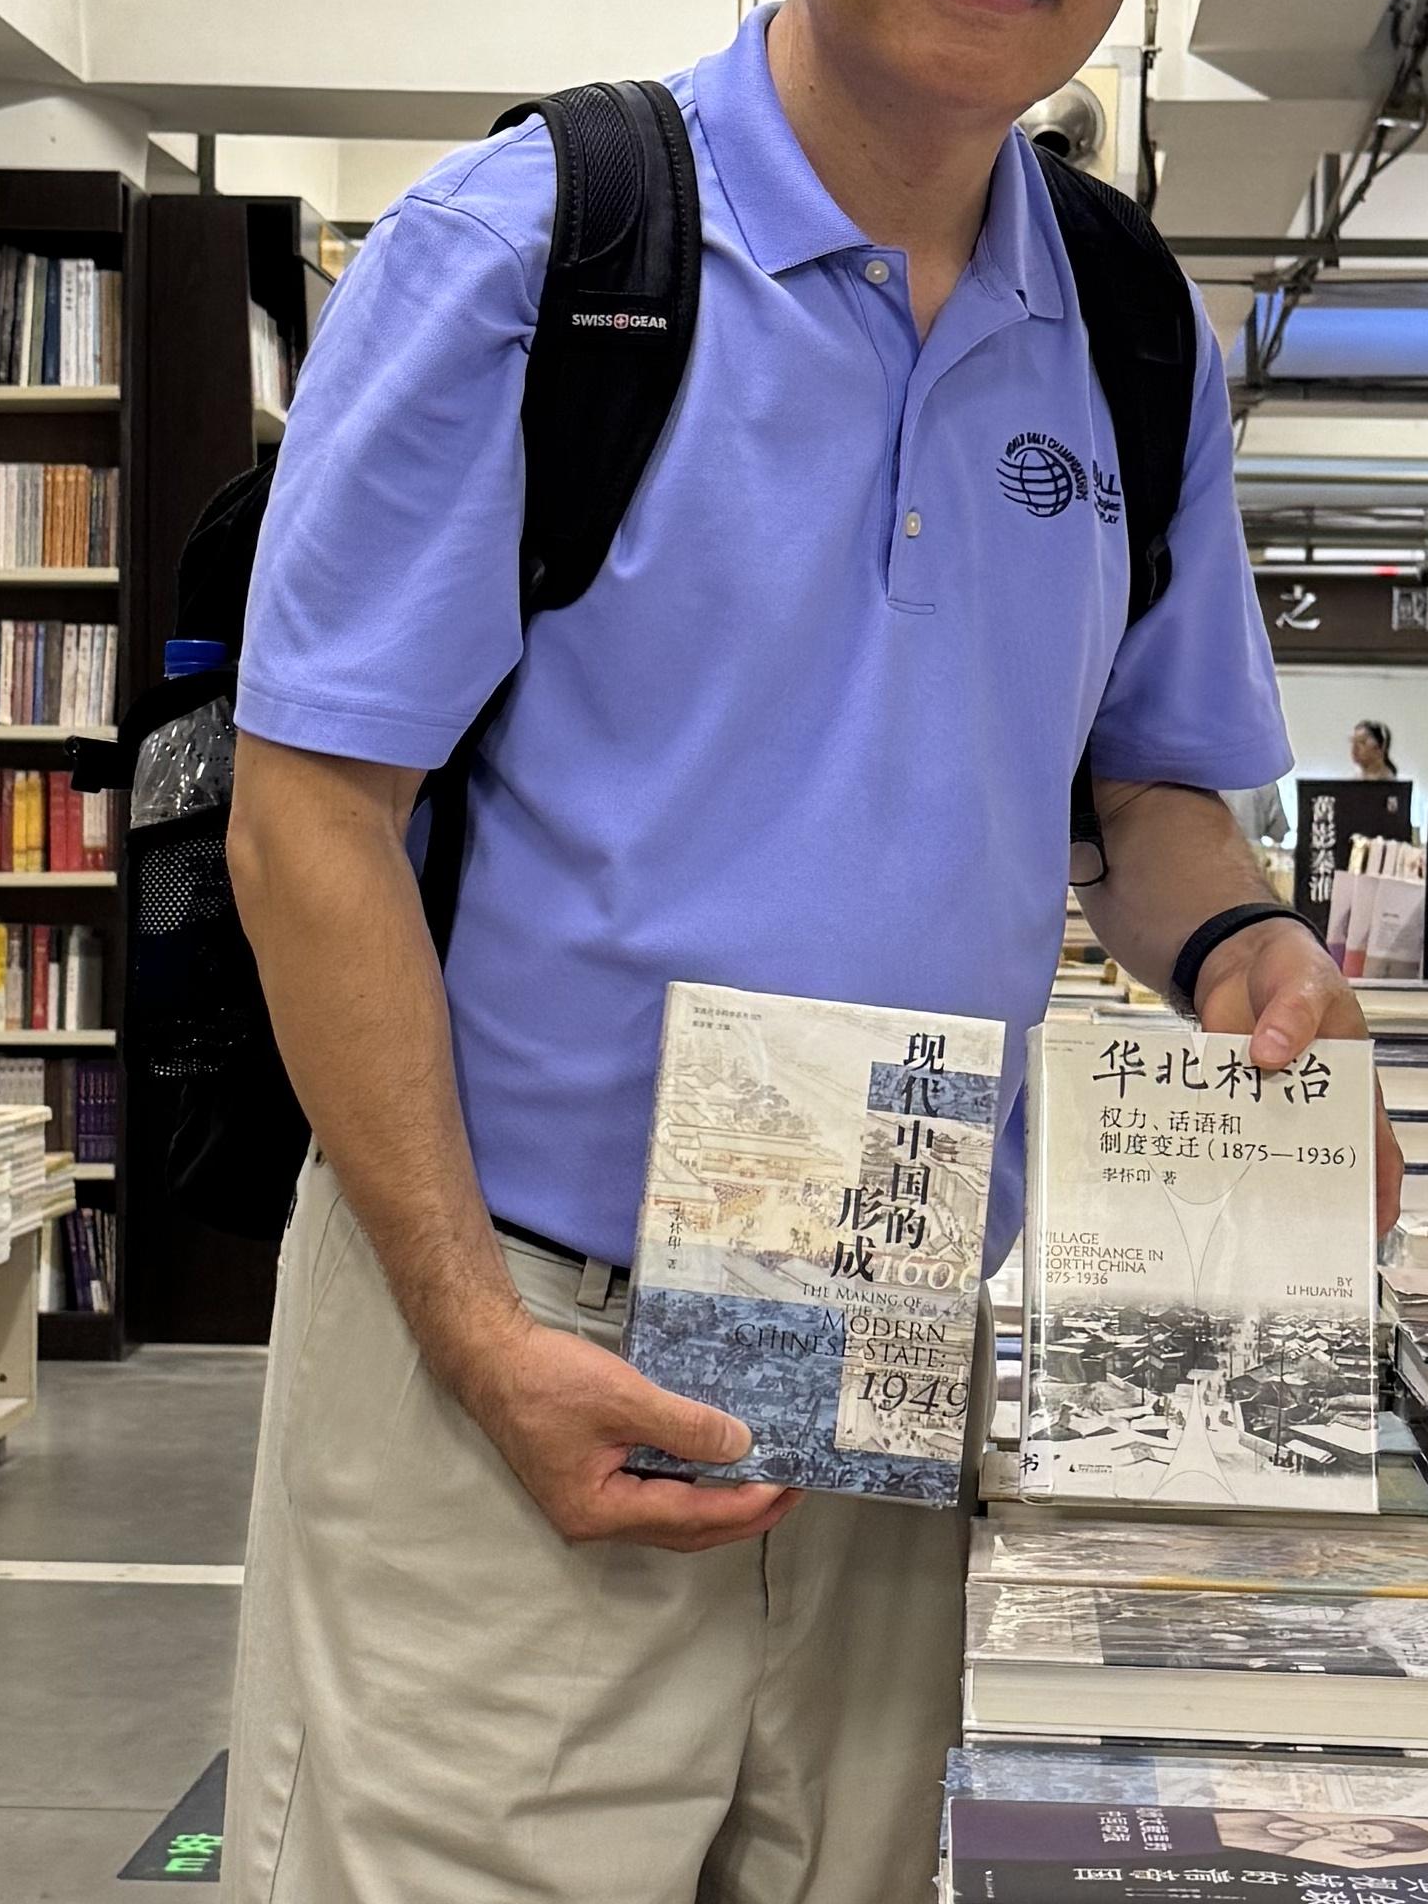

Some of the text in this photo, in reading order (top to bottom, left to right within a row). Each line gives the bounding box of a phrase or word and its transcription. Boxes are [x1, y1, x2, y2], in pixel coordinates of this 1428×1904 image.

[572, 314, 668, 330] SWISS GEAR
[1092, 1038, 1332, 1104] 华北村治
[1099, 1105, 1243, 1135] 权力、话语和
[883, 1032, 947, 1250] 现代中国的
[1101, 1167, 1152, 1184] 李怀印
[831, 1187, 886, 1283] 形成
[1098, 1259, 1147, 1274] CHINA
[1148, 1249, 1164, 1262] IN
[1044, 1271, 1109, 1286] 875-1936
[1286, 1285, 1353, 1298] LI HUAIYIN
[1337, 1276, 1353, 1287] BY
[802, 1282, 922, 1309] THE MAKING OF
[822, 1309, 947, 1344] MODERN
[735, 1323, 947, 1369] CHINESE STATE:
[856, 1371, 971, 1418] 1949
